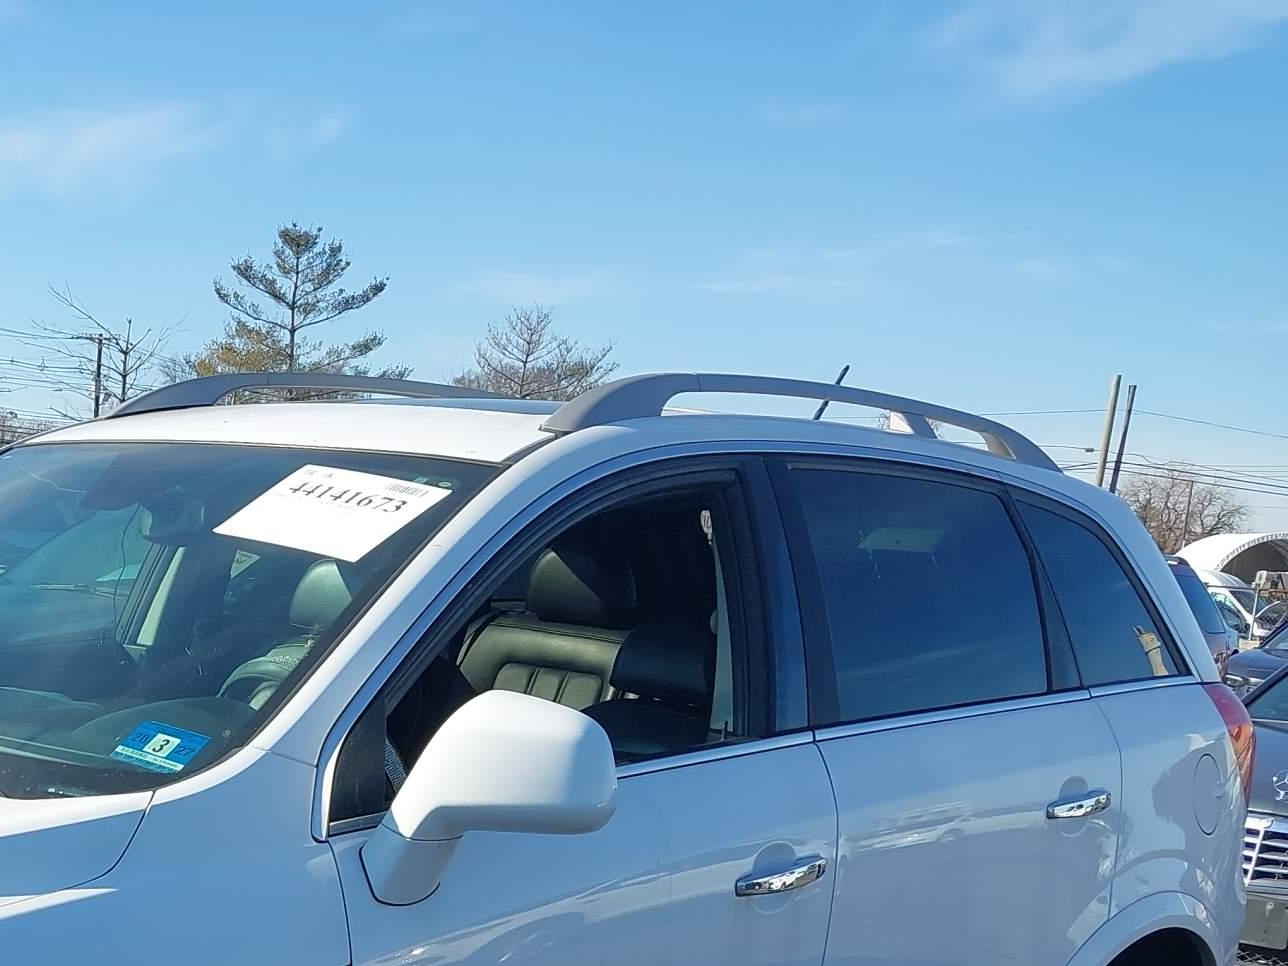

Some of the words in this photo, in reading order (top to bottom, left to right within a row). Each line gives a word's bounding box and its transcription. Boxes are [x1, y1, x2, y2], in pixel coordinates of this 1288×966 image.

[289, 481, 408, 513] 44141673
[133, 732, 150, 744] 20
[152, 738, 170, 753] 3
[174, 745, 195, 757] 27
